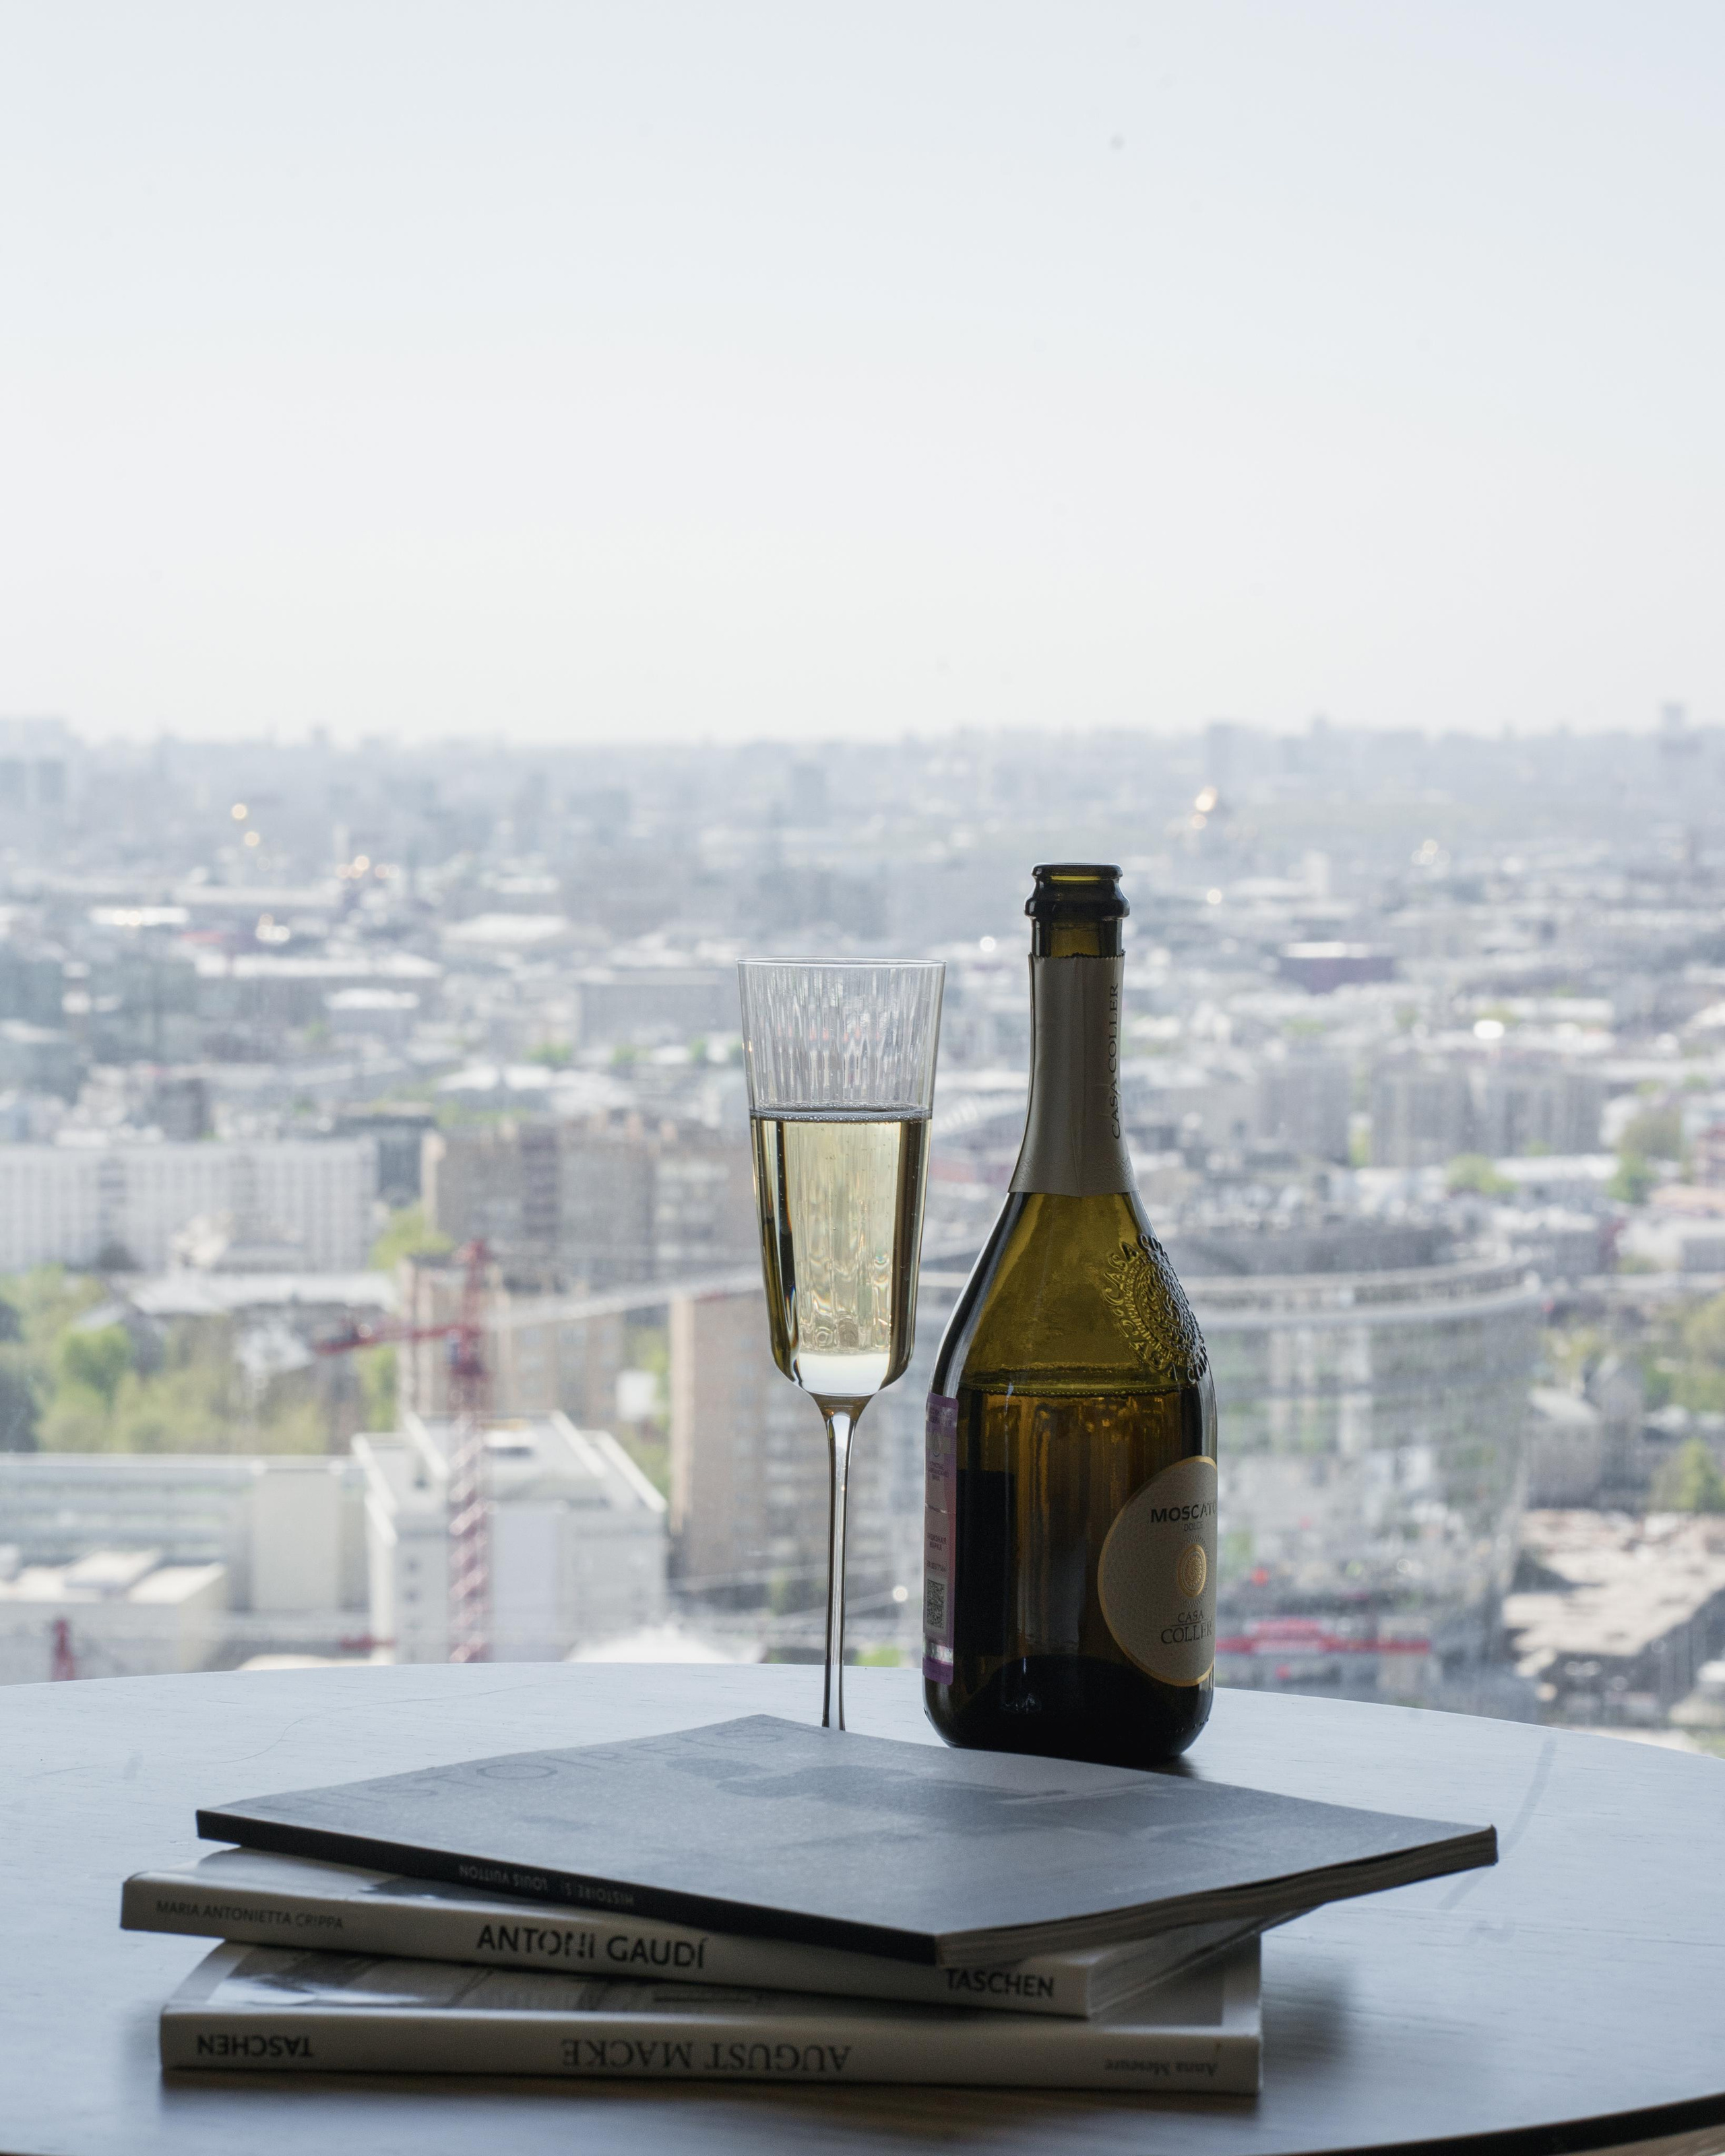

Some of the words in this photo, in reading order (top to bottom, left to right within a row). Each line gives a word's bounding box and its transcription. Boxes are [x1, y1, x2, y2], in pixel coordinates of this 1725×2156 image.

[1108, 982, 1119, 1074] COLLER
[1110, 1077, 1121, 1140] CASA
[1161, 1621, 1212, 1644] COLLER
[1177, 1610, 1204, 1624] CASA
[458, 1864, 509, 1884] VUITTON
[512, 1872, 548, 1891] LOUIS
[155, 1899, 199, 1917] MARIA
[201, 1905, 292, 1925] ANTONIETTA
[295, 1913, 344, 1930] CRIPPA
[477, 1924, 596, 1959] ANTONI
[606, 1934, 708, 1969] GAUDÍ
[945, 1967, 1055, 1998] TASCHEN
[197, 2033, 313, 2058] TASCHEN
[561, 2038, 693, 2069] MACKE
[705, 2041, 852, 2072] AUGUST
[1174, 2062, 1218, 2077] Anna
